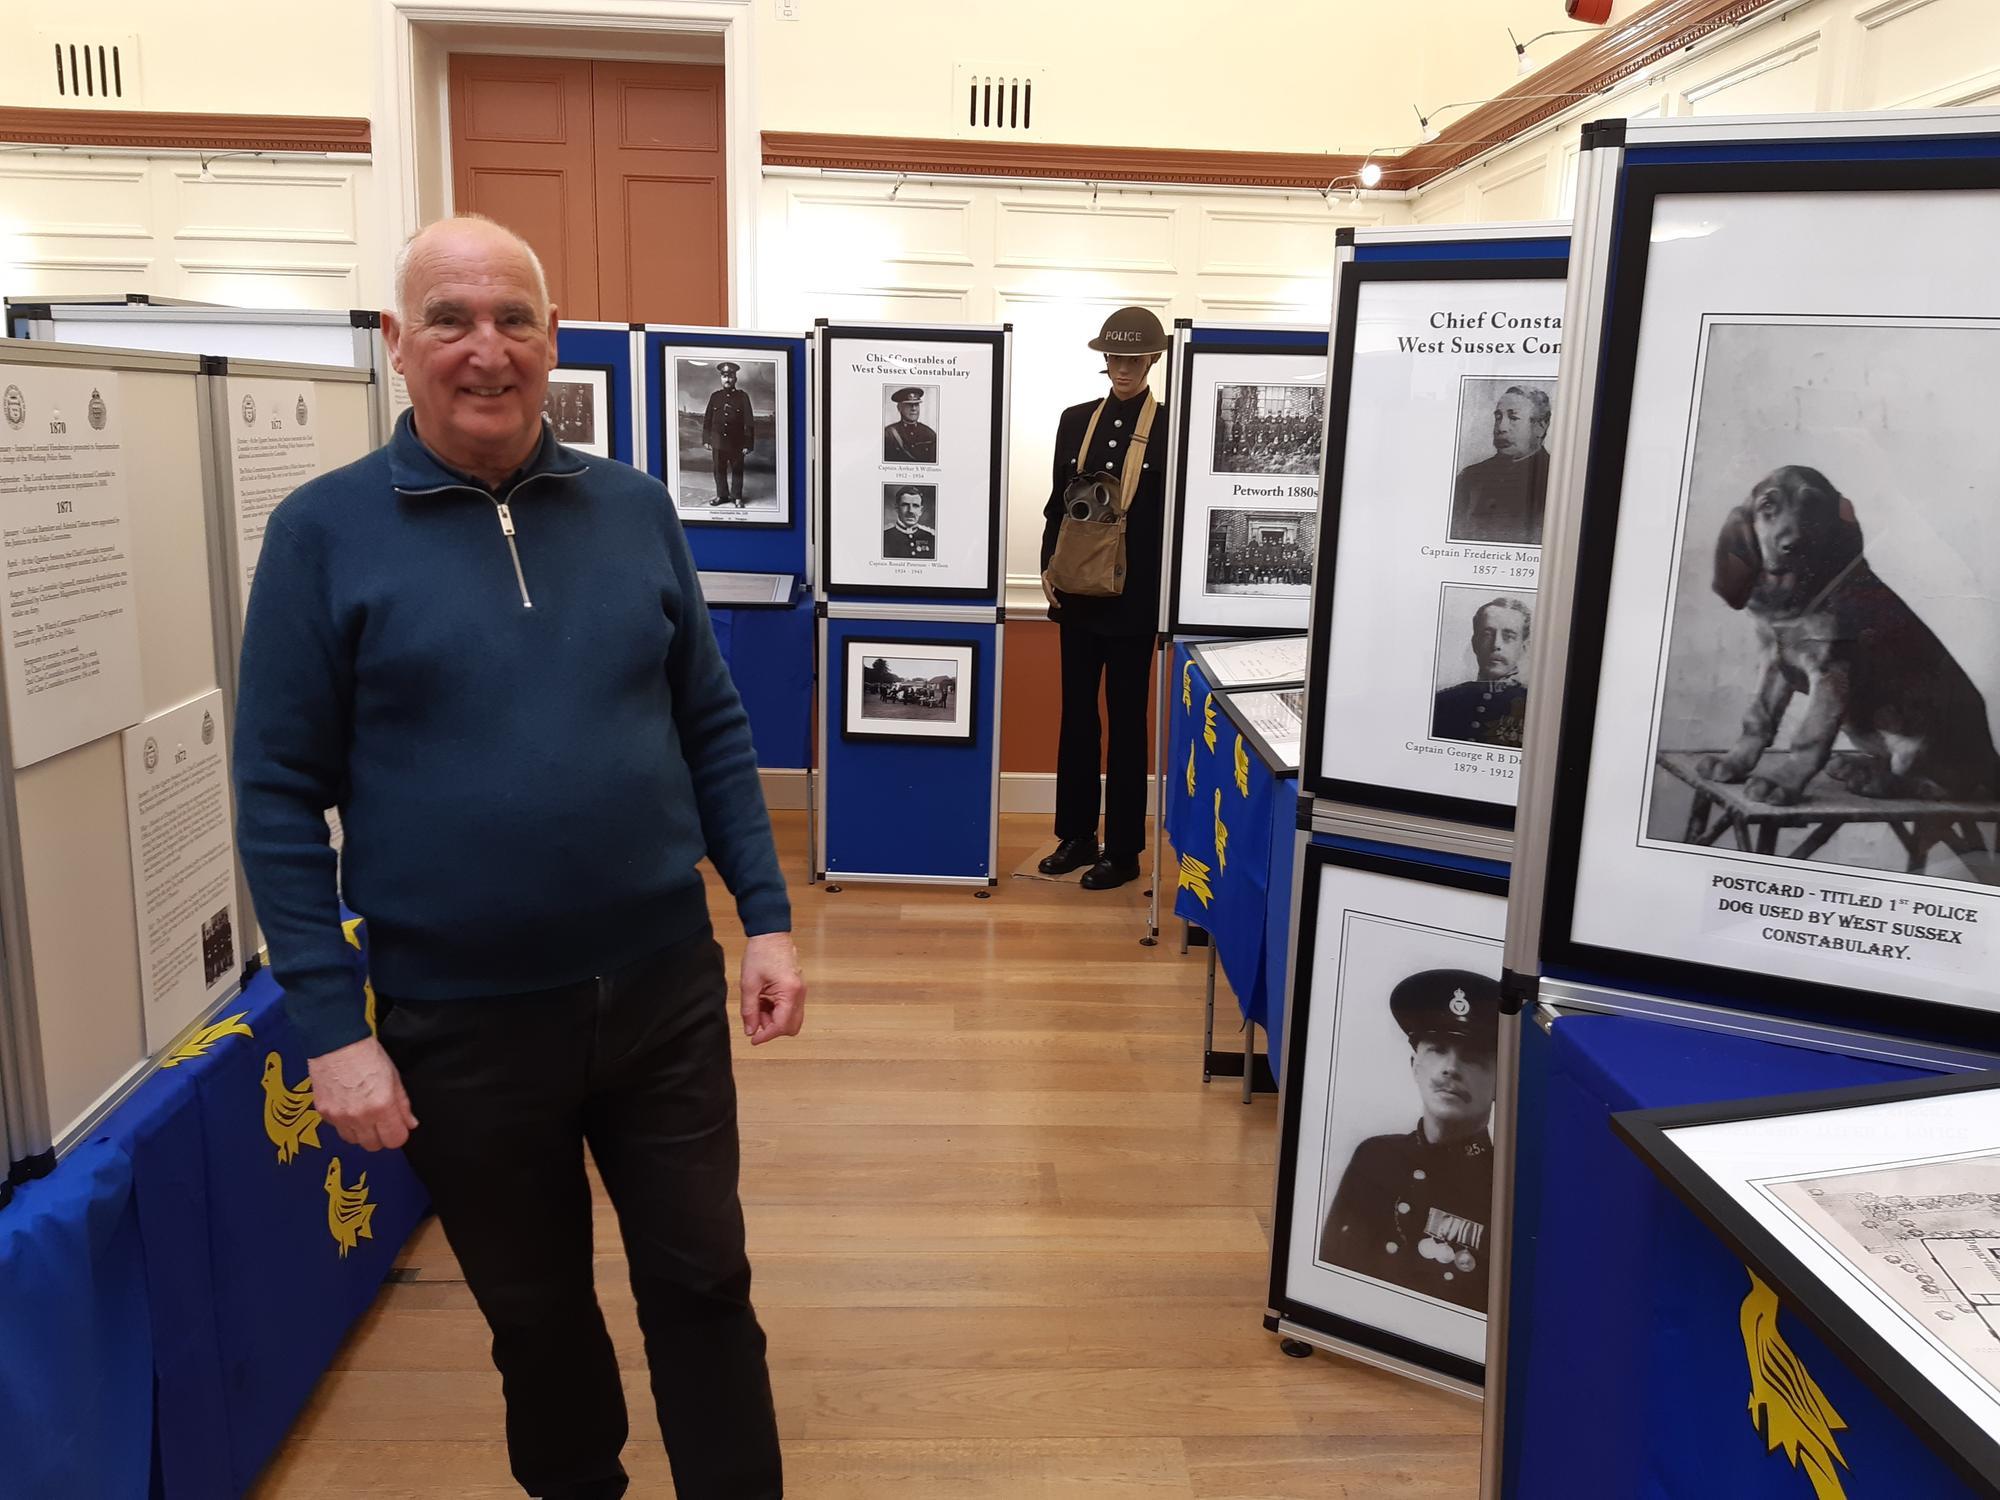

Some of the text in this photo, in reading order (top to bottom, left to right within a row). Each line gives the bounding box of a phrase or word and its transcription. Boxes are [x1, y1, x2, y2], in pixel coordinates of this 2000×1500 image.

[1430, 311, 1562, 329] Chief Consta
[1104, 330, 1142, 342] POLICE
[1397, 336, 1445, 353] West
[1451, 336, 1515, 354] Sussex
[946, 356, 958, 365] of
[852, 364, 970, 379] West Sussex Constabulary
[50, 422, 66, 434] 1870
[1233, 484, 1319, 498] Petworth 1880s
[56, 501, 72, 514] 1871
[1420, 546, 1460, 558] Captain
[1464, 548, 1512, 561] Frederick
[1473, 565, 1498, 576] 1857
[1510, 567, 1535, 578] 1879
[1405, 742, 1444, 754] Captain
[1446, 746, 1482, 761] George
[1486, 752, 1494, 762] R
[1498, 754, 1505, 763] B
[1454, 762, 1478, 774] 1879
[1490, 768, 1514, 779] 1912
[1712, 875, 1804, 898] POSTCARD
[1820, 889, 1882, 910] TITLED
[1912, 901, 1978, 922] POLICE
[1718, 898, 1963, 945] DOG USED BY WEST SUSSEX
[1762, 927, 1912, 960] CONSTABULARY.
